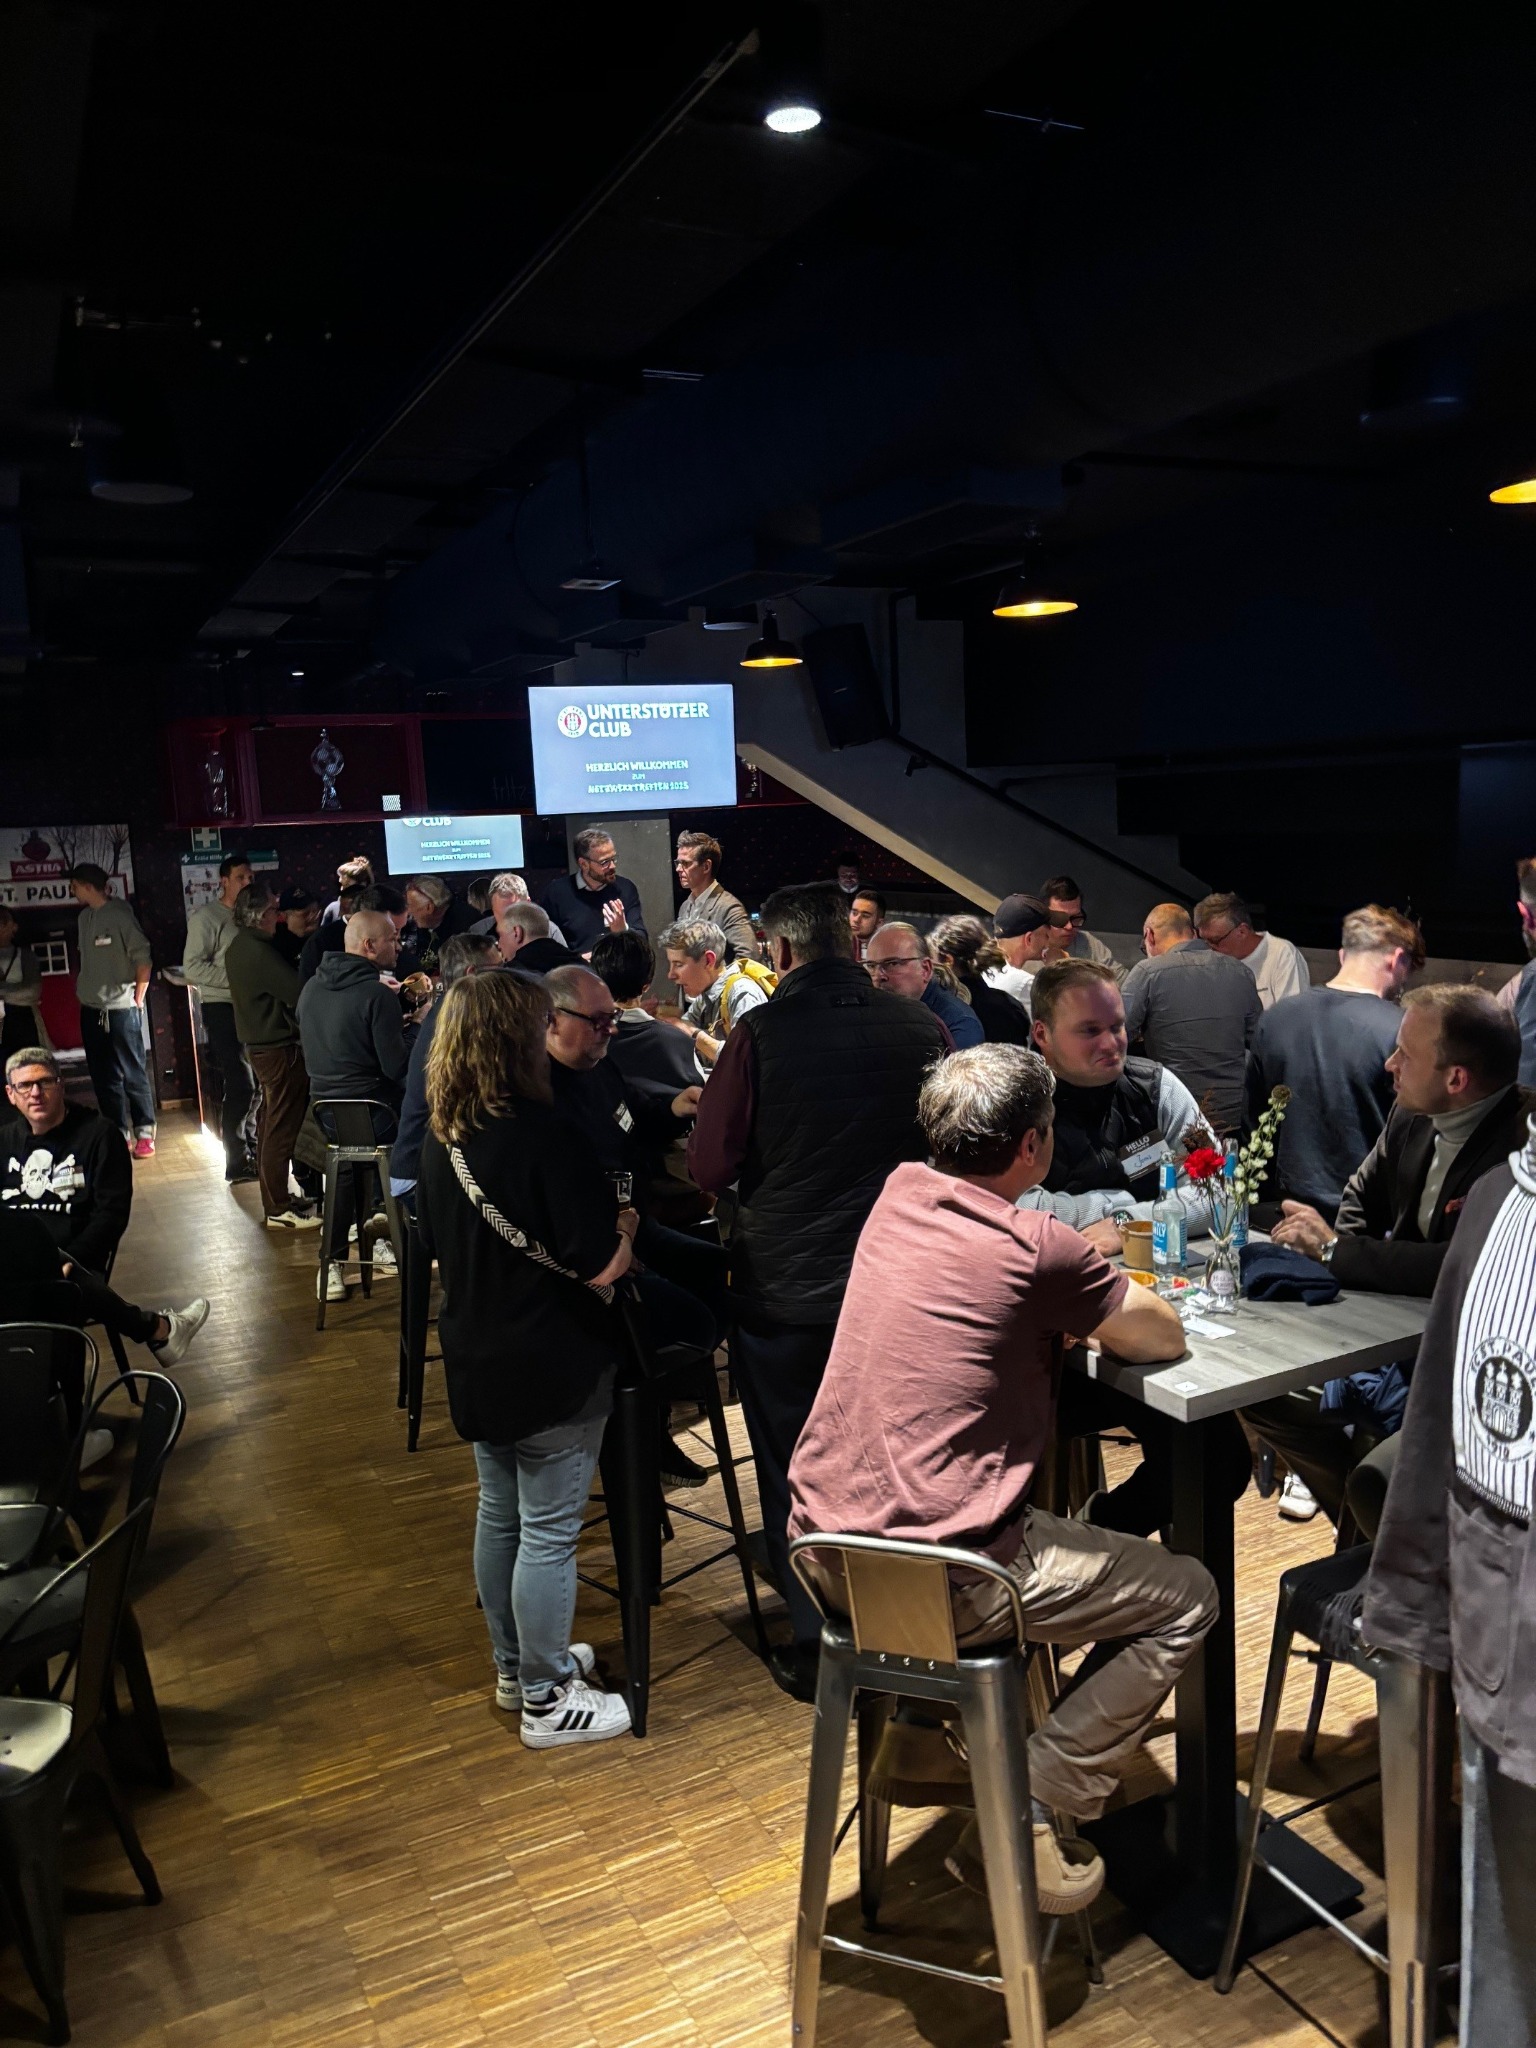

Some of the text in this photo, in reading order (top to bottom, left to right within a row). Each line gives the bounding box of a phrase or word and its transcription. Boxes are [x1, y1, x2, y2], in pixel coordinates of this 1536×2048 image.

[586, 702, 710, 720] UNTERSTÜTZER
[588, 721, 632, 738] CLUB
[585, 760, 689, 772] HERZLICH WILLKOMMEN
[422, 817, 452, 827] CLUB
[15, 863, 62, 875] ASTRA
[1125, 1136, 1150, 1153] HELLO
